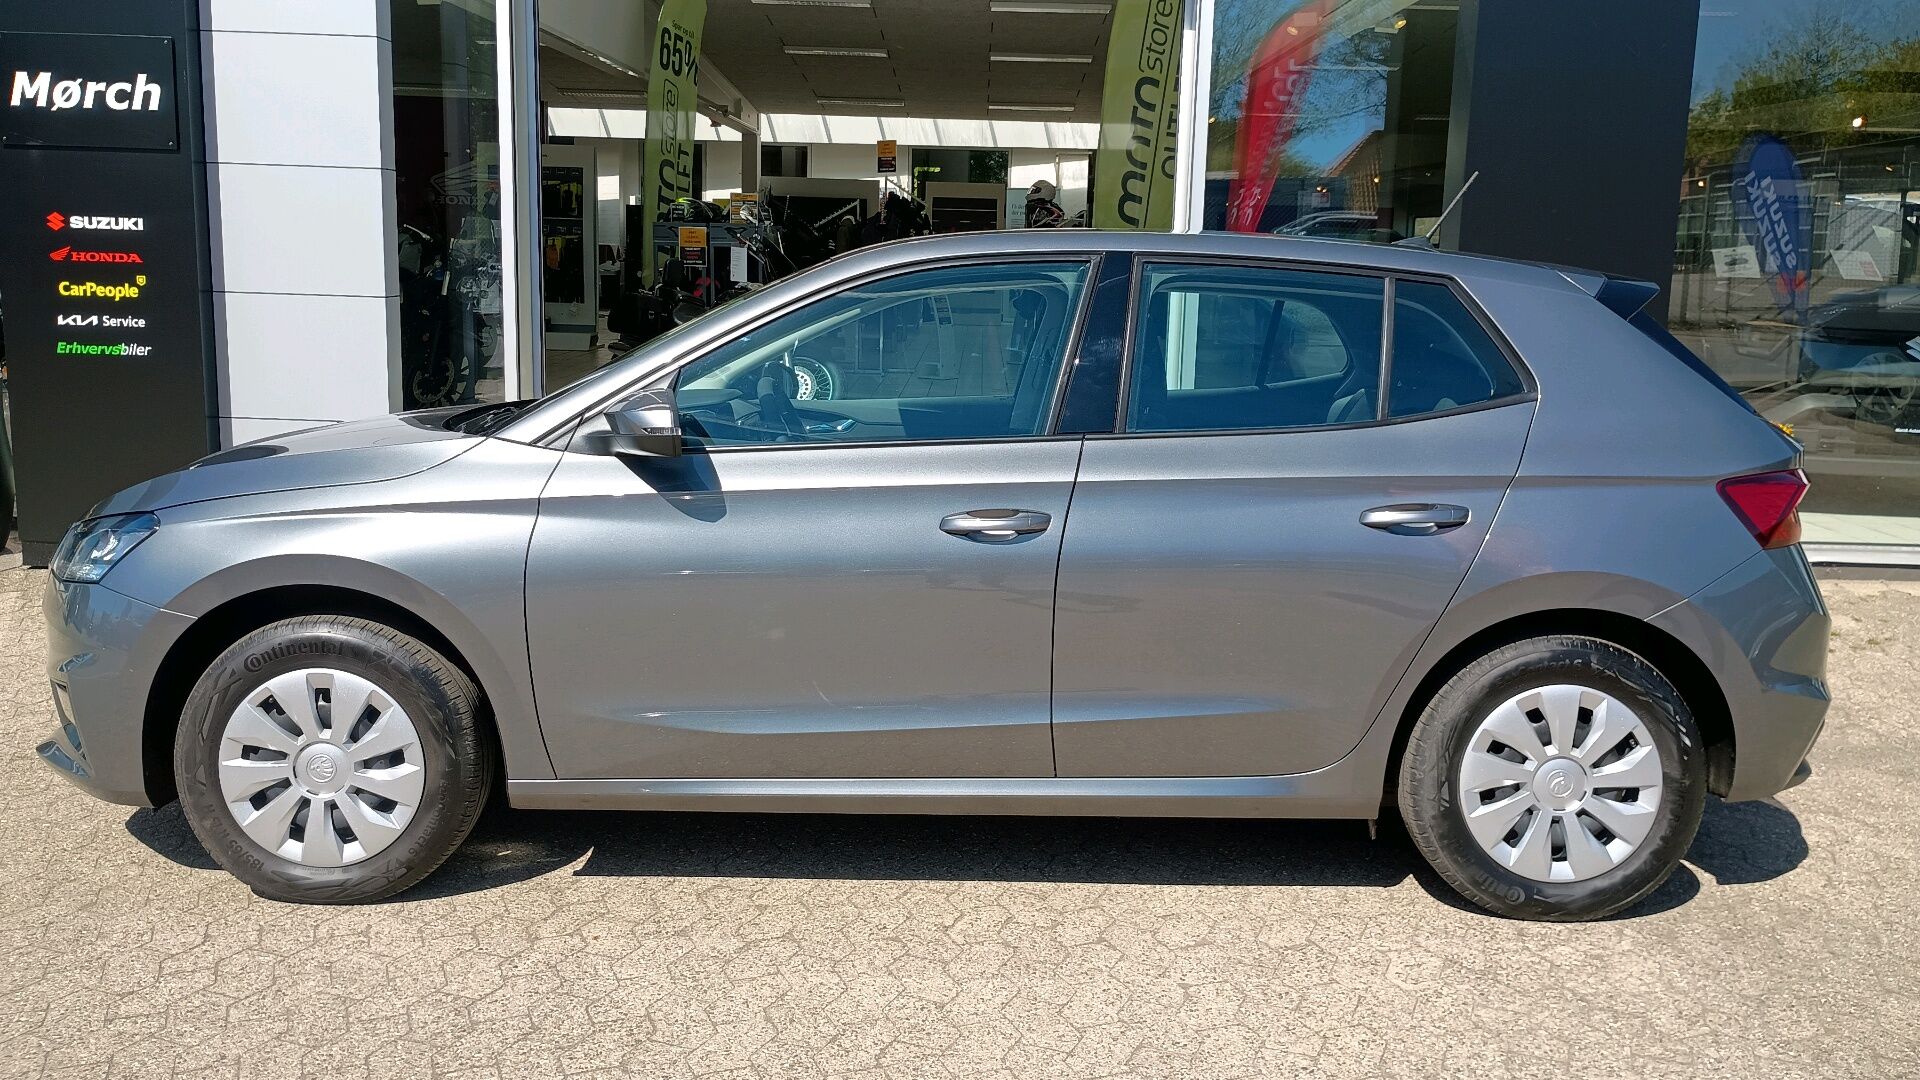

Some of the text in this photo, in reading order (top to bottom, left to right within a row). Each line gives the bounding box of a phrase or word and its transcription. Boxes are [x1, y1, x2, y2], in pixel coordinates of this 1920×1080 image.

[9, 71, 162, 112] Mørch
[69, 215, 144, 231] SUZUKI
[71, 251, 144, 263] HONDA
[58, 281, 139, 301] CarPeople
[57, 314, 146, 328] KIA Service
[56, 341, 152, 356] Erhvervsbiler
[243, 640, 345, 673] Continental
